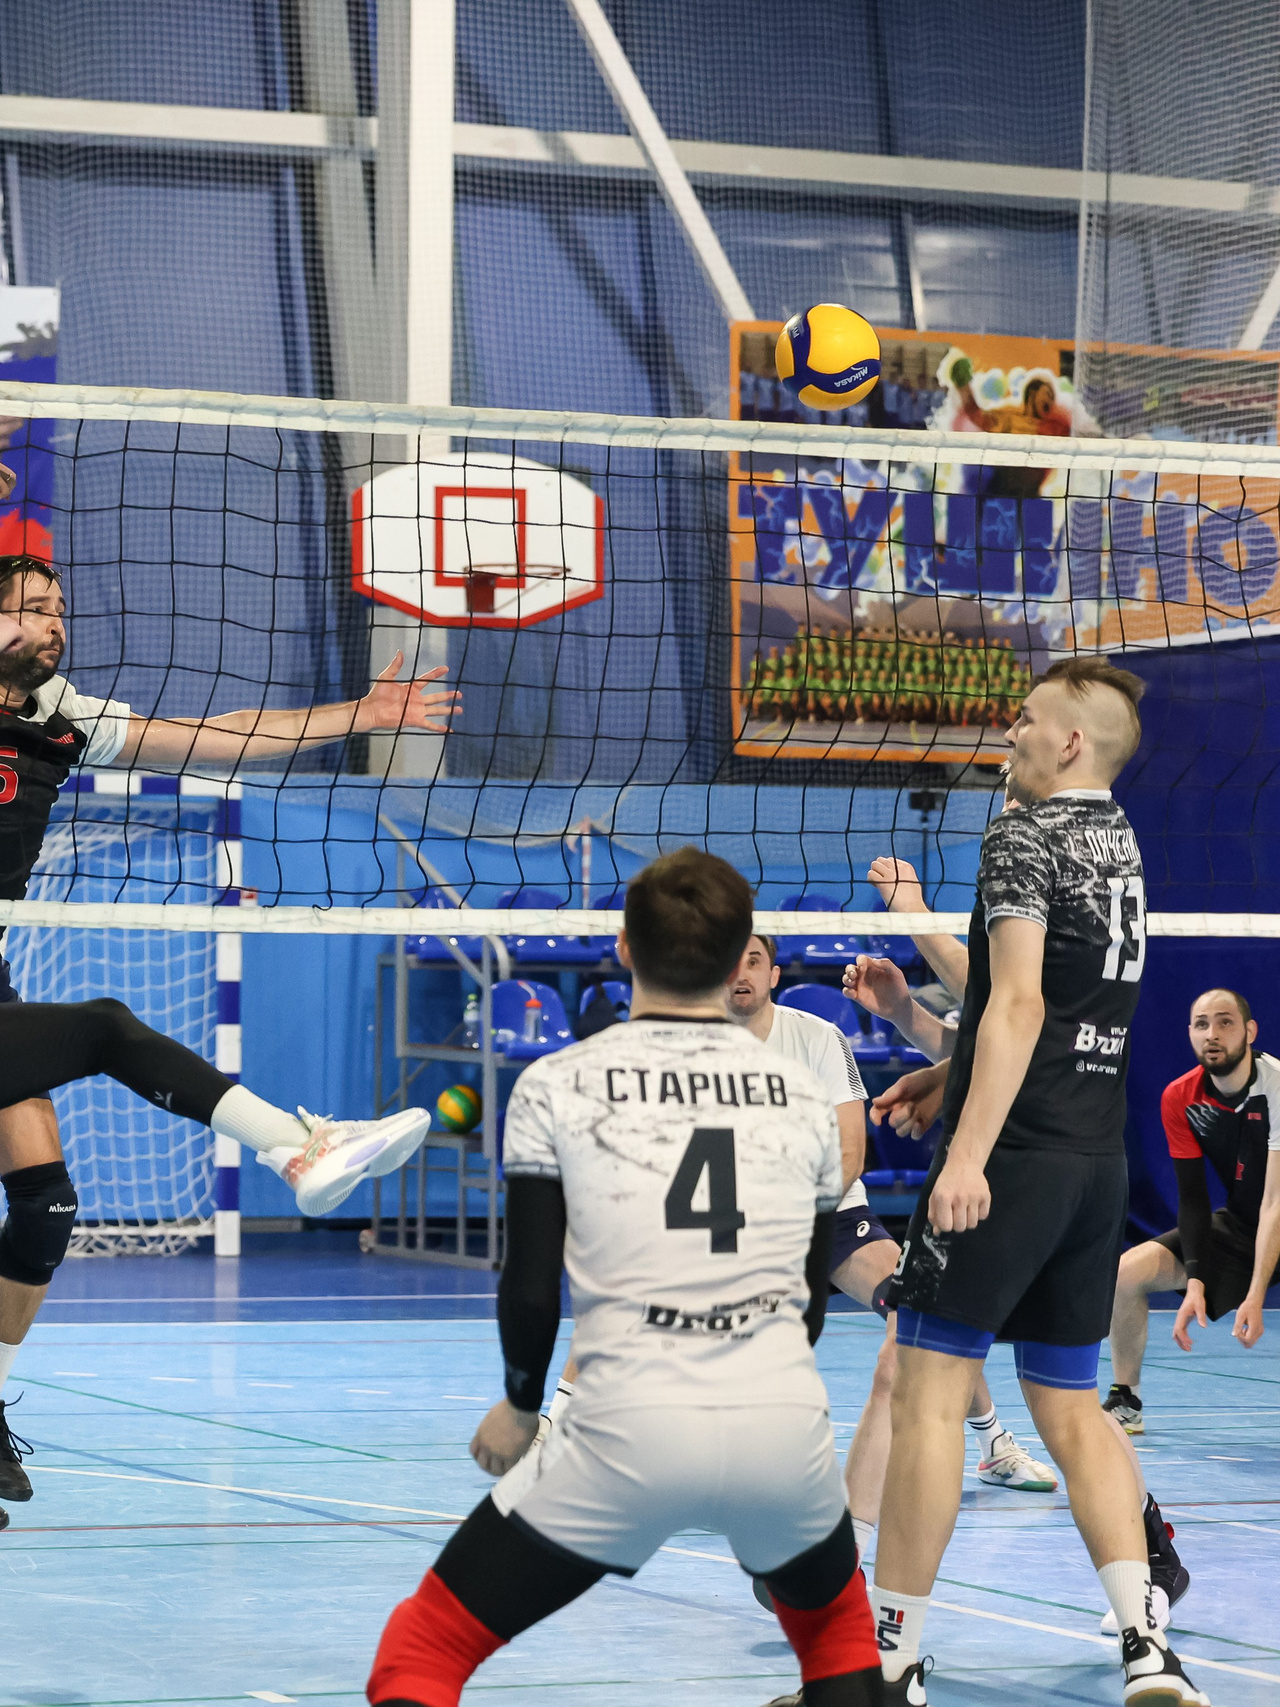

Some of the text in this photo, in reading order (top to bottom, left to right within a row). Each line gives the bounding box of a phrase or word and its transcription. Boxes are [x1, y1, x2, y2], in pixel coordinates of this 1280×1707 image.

[1102, 876, 1147, 982] 13
[606, 1068, 788, 1108] СТАРЦЕВ
[664, 1127, 746, 1254] 4
[877, 1605, 905, 1651] FILA
